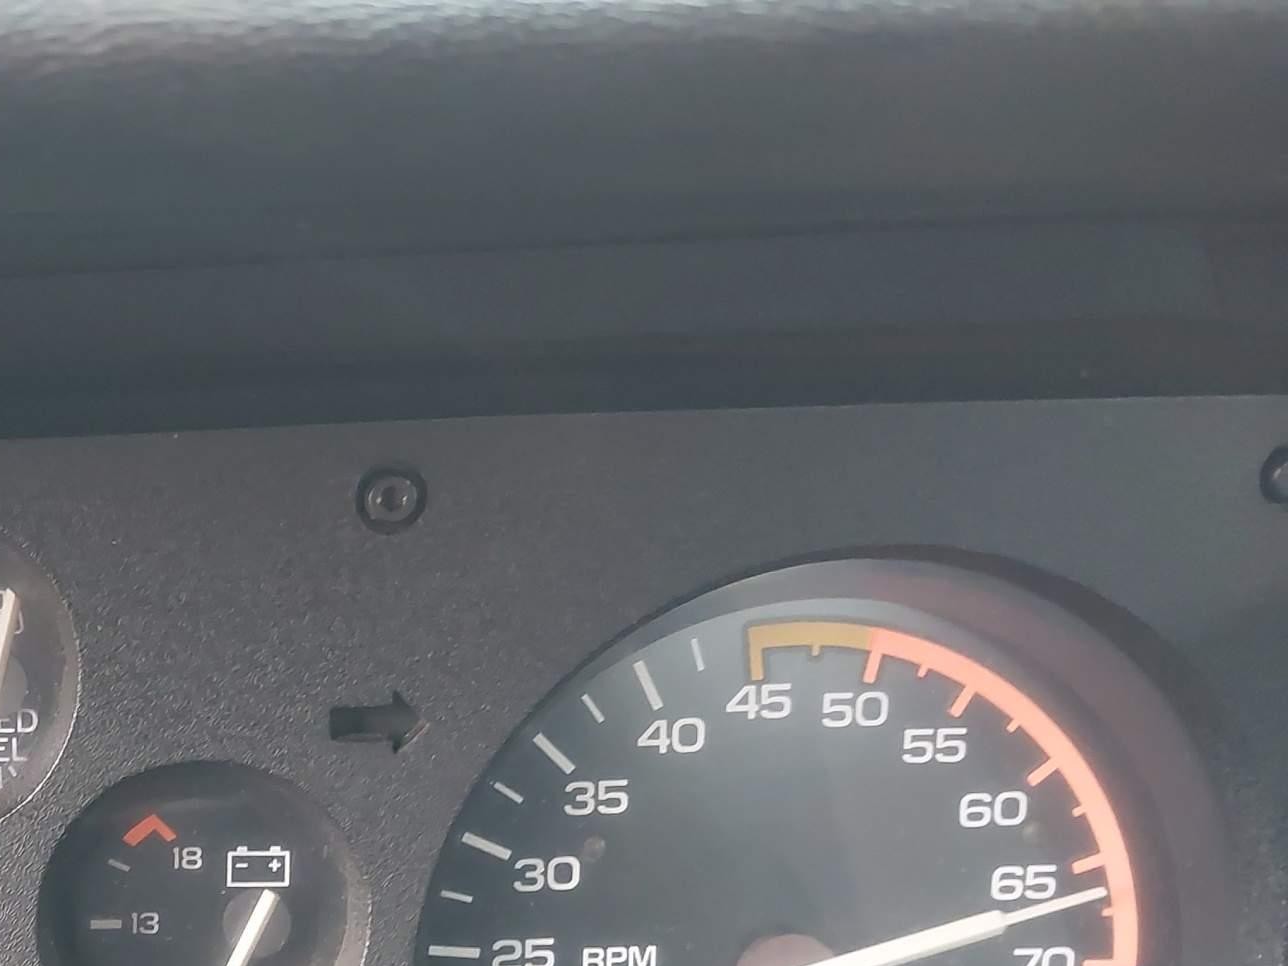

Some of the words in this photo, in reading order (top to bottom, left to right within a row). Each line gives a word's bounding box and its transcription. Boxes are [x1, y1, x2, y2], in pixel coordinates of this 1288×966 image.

[725, 684, 792, 720] 45
[821, 692, 889, 728] 50
[637, 718, 706, 754] 40
[902, 728, 967, 764] 55
[564, 780, 629, 816] 35
[959, 791, 1028, 827] 60
[173, 847, 203, 870] 18
[513, 856, 581, 892] 30
[990, 864, 1057, 900] 65
[131, 912, 159, 934] 13
